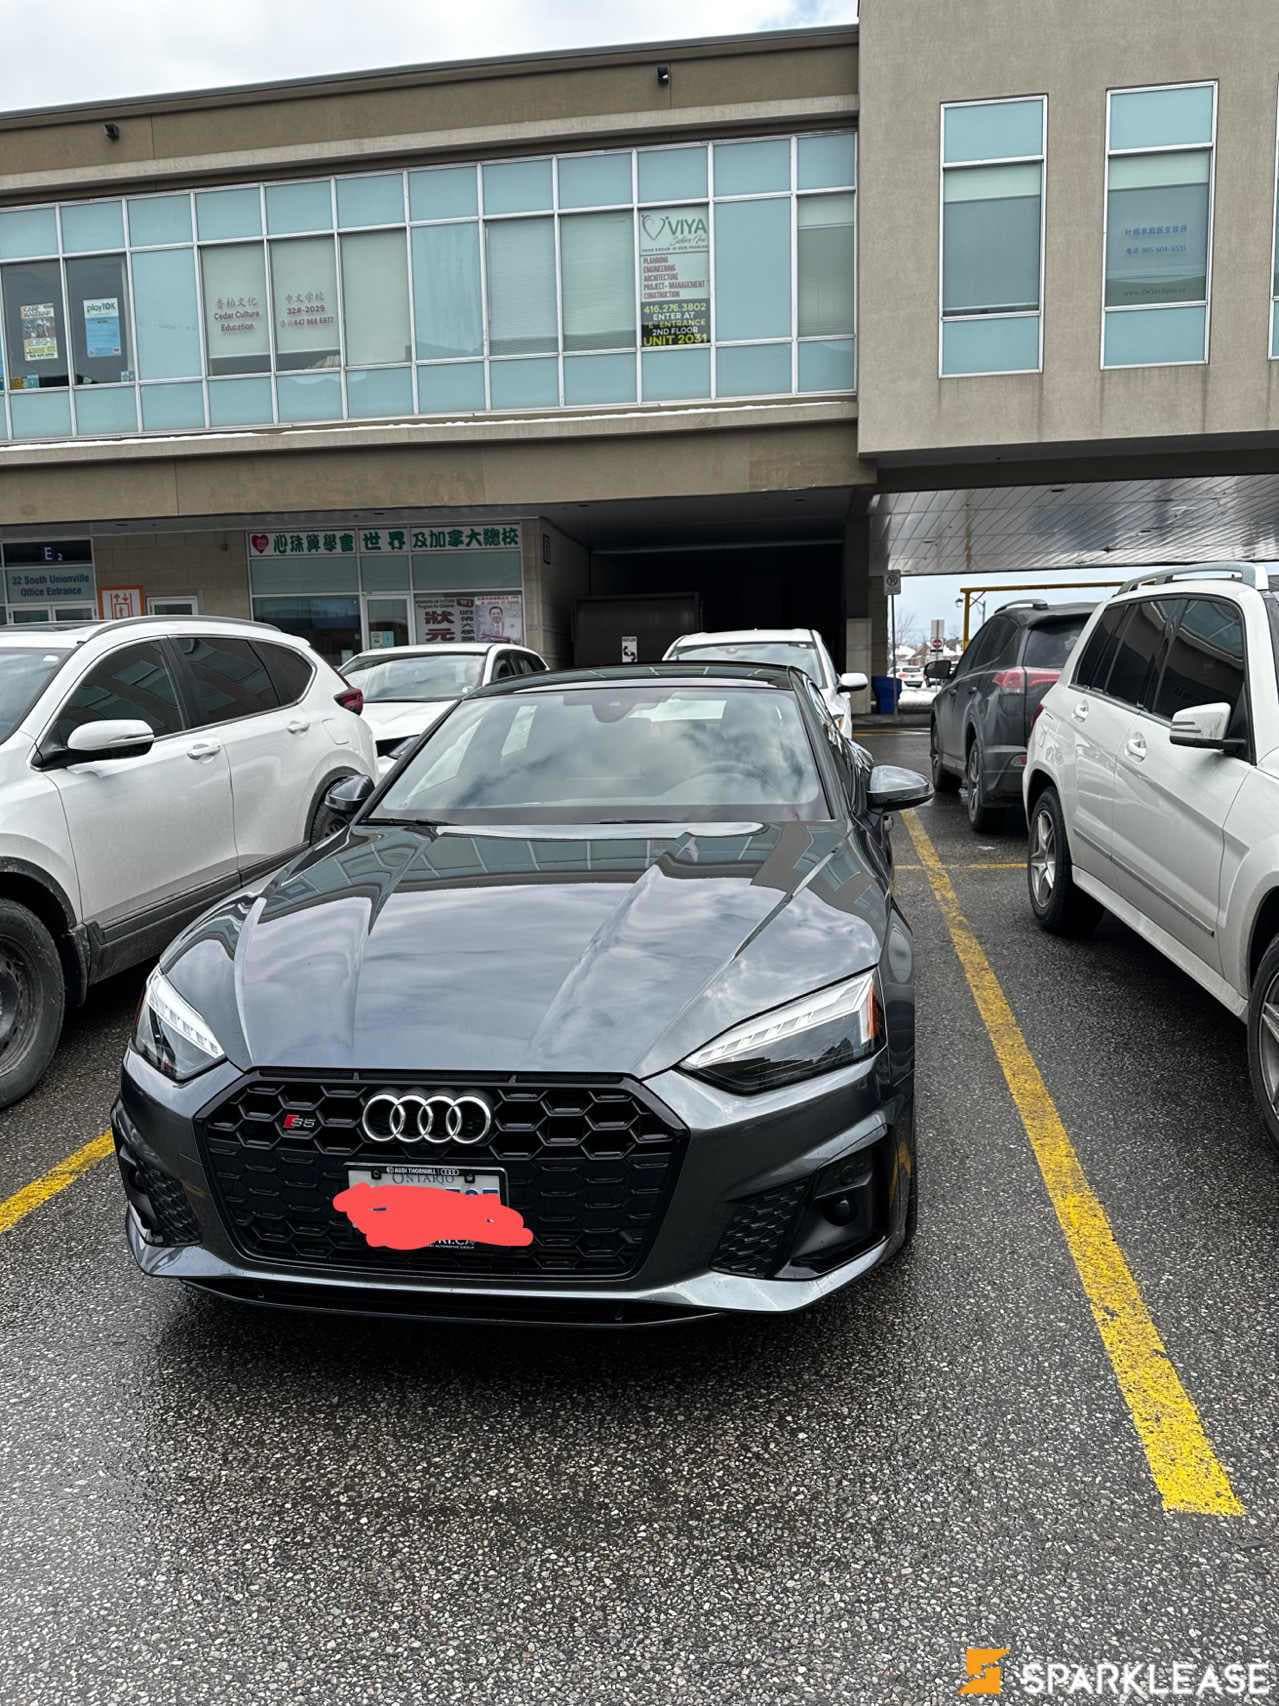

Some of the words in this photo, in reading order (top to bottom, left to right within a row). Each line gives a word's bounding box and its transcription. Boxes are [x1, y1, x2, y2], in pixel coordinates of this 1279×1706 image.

[667, 218, 708, 235] VIYA
[652, 312, 681, 321] ENTER
[220, 323, 256, 332] Education
[659, 319, 706, 328] ENTRANCE
[652, 328, 669, 336] 2ND
[670, 327, 699, 335] FLOOR
[643, 335, 673, 346] UNIT
[677, 333, 708, 344] 2031
[24, 575, 48, 585] South
[49, 573, 89, 584] Unionville
[20, 587, 44, 597] Office
[46, 586, 82, 596] Entrance
[392, 1173, 455, 1185] ONTARIO
